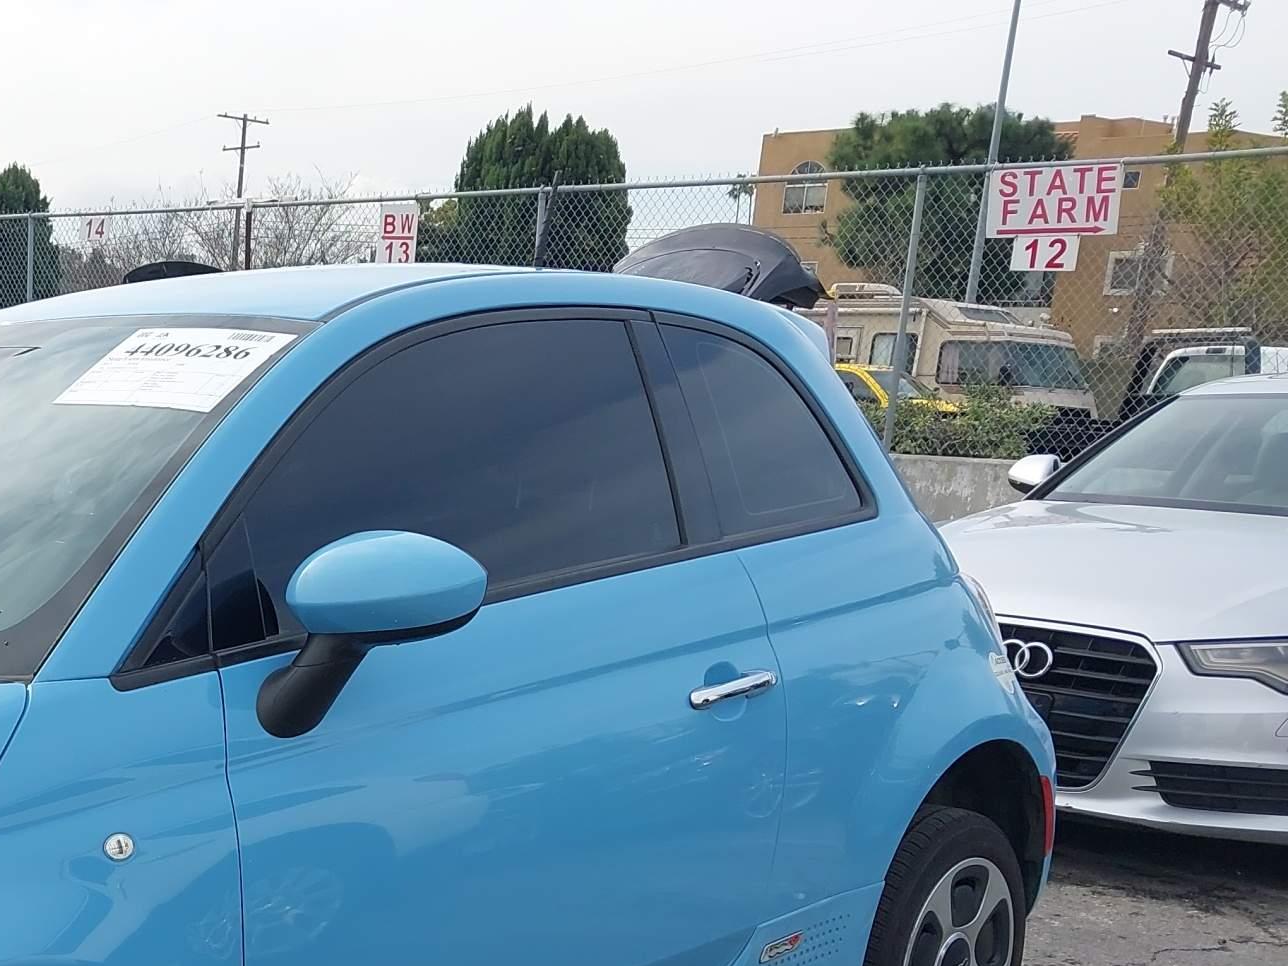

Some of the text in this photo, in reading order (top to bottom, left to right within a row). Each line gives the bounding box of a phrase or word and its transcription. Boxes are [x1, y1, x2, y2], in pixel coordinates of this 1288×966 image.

[999, 166, 1117, 198] STATE
[1001, 195, 1110, 226] FARM
[86, 218, 105, 238] 14
[383, 213, 414, 235] BW
[385, 241, 410, 263] 13
[1025, 238, 1067, 269] 12
[124, 342, 257, 360] 44096286
